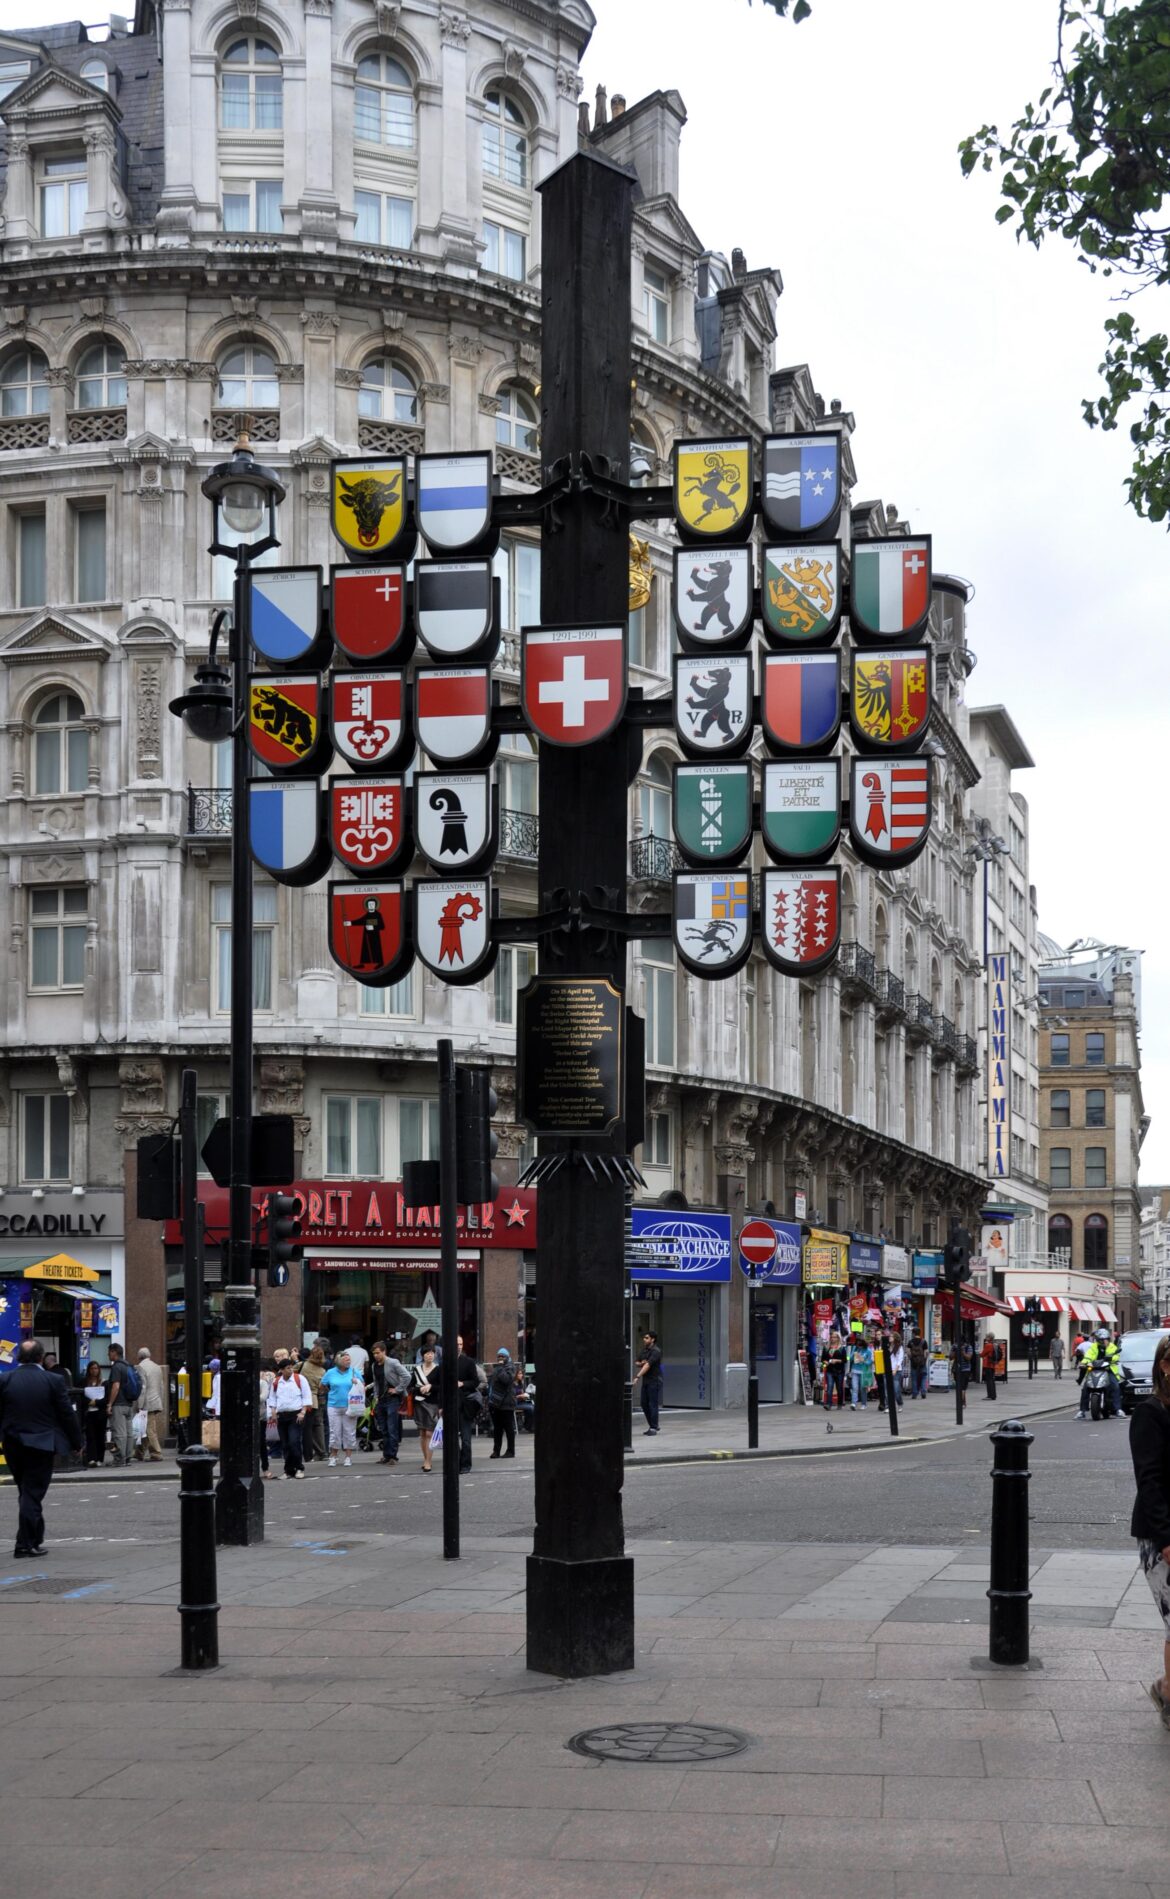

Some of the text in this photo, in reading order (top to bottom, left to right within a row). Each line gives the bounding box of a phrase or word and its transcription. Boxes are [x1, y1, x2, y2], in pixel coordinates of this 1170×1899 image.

[354, 568, 381, 576] SCHWYZ
[348, 778, 386, 786] NIDWALDEN
[432, 776, 472, 784] BASEL-STADT
[778, 776, 824, 788] LIBERTÉ
[794, 788, 808, 797] ET
[782, 796, 820, 807] PATRIE
[420, 882, 484, 890] BASEL-LANDSCHAFT
[991, 956, 1006, 1175] MAMMA MIA
[366, 1191, 382, 1226] A
[301, 1229, 332, 1238] reshly
[337, 1230, 384, 1238] prepared
[674, 1240, 730, 1256] EXCHANGE
[324, 1260, 358, 1268] SANDWICHES
[43, 1264, 83, 1278] THEATRE TICKETS
